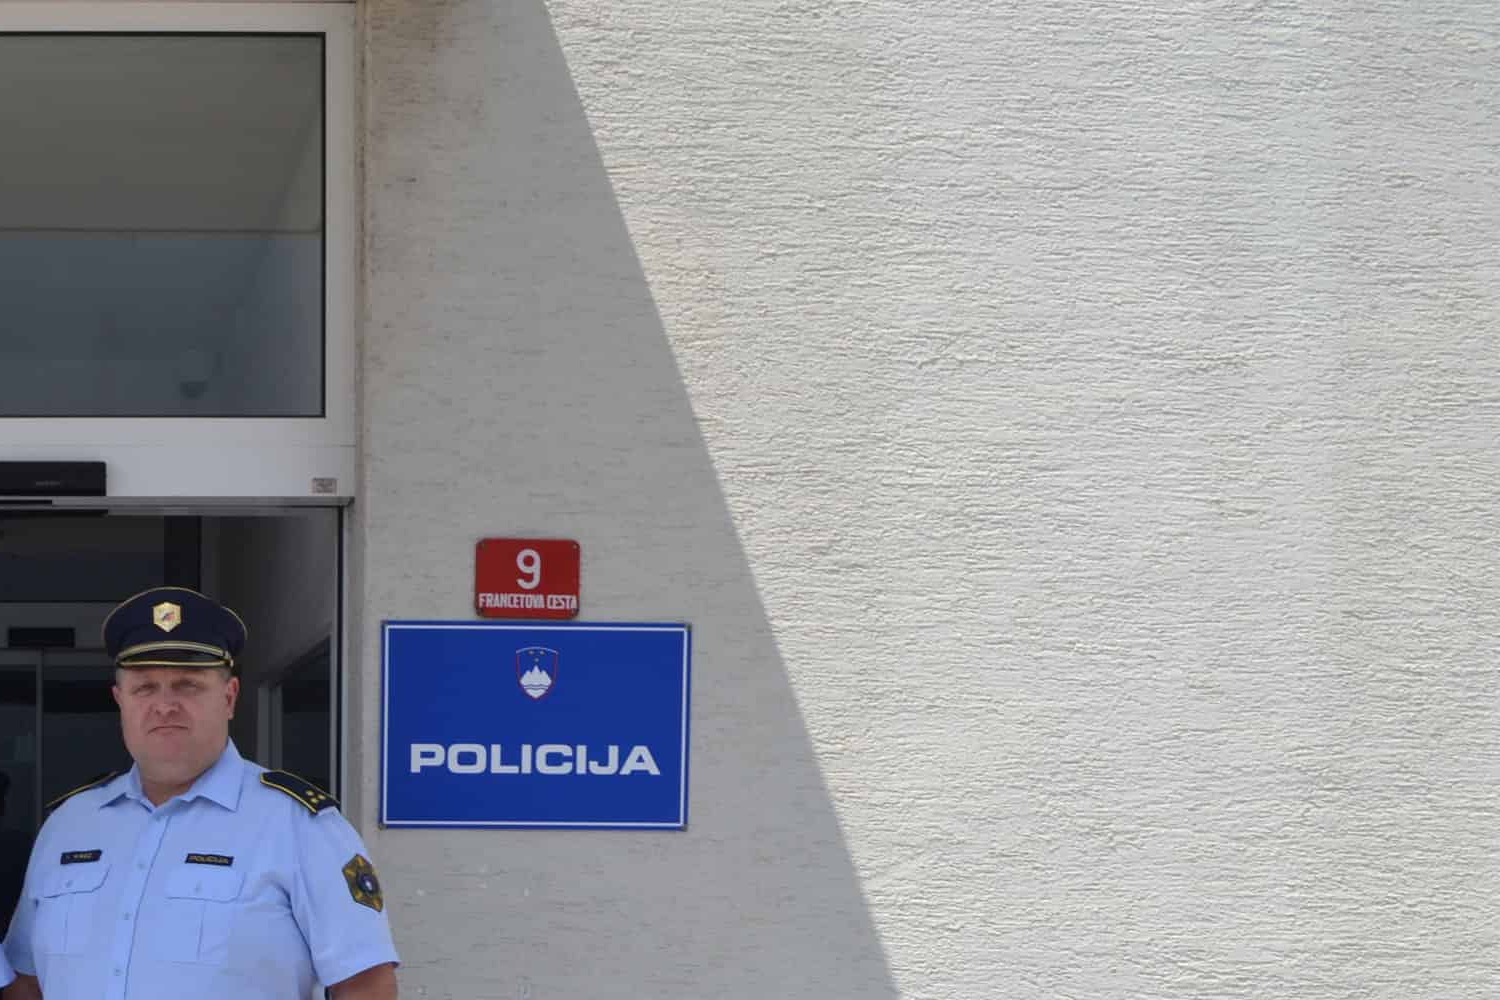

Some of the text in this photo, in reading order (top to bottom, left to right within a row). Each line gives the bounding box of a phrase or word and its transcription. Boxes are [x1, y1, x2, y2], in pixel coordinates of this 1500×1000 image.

[516, 549, 541, 590] 9
[478, 593, 577, 610] FRANCETOVA CESTA
[410, 743, 661, 776] POLICIJA
